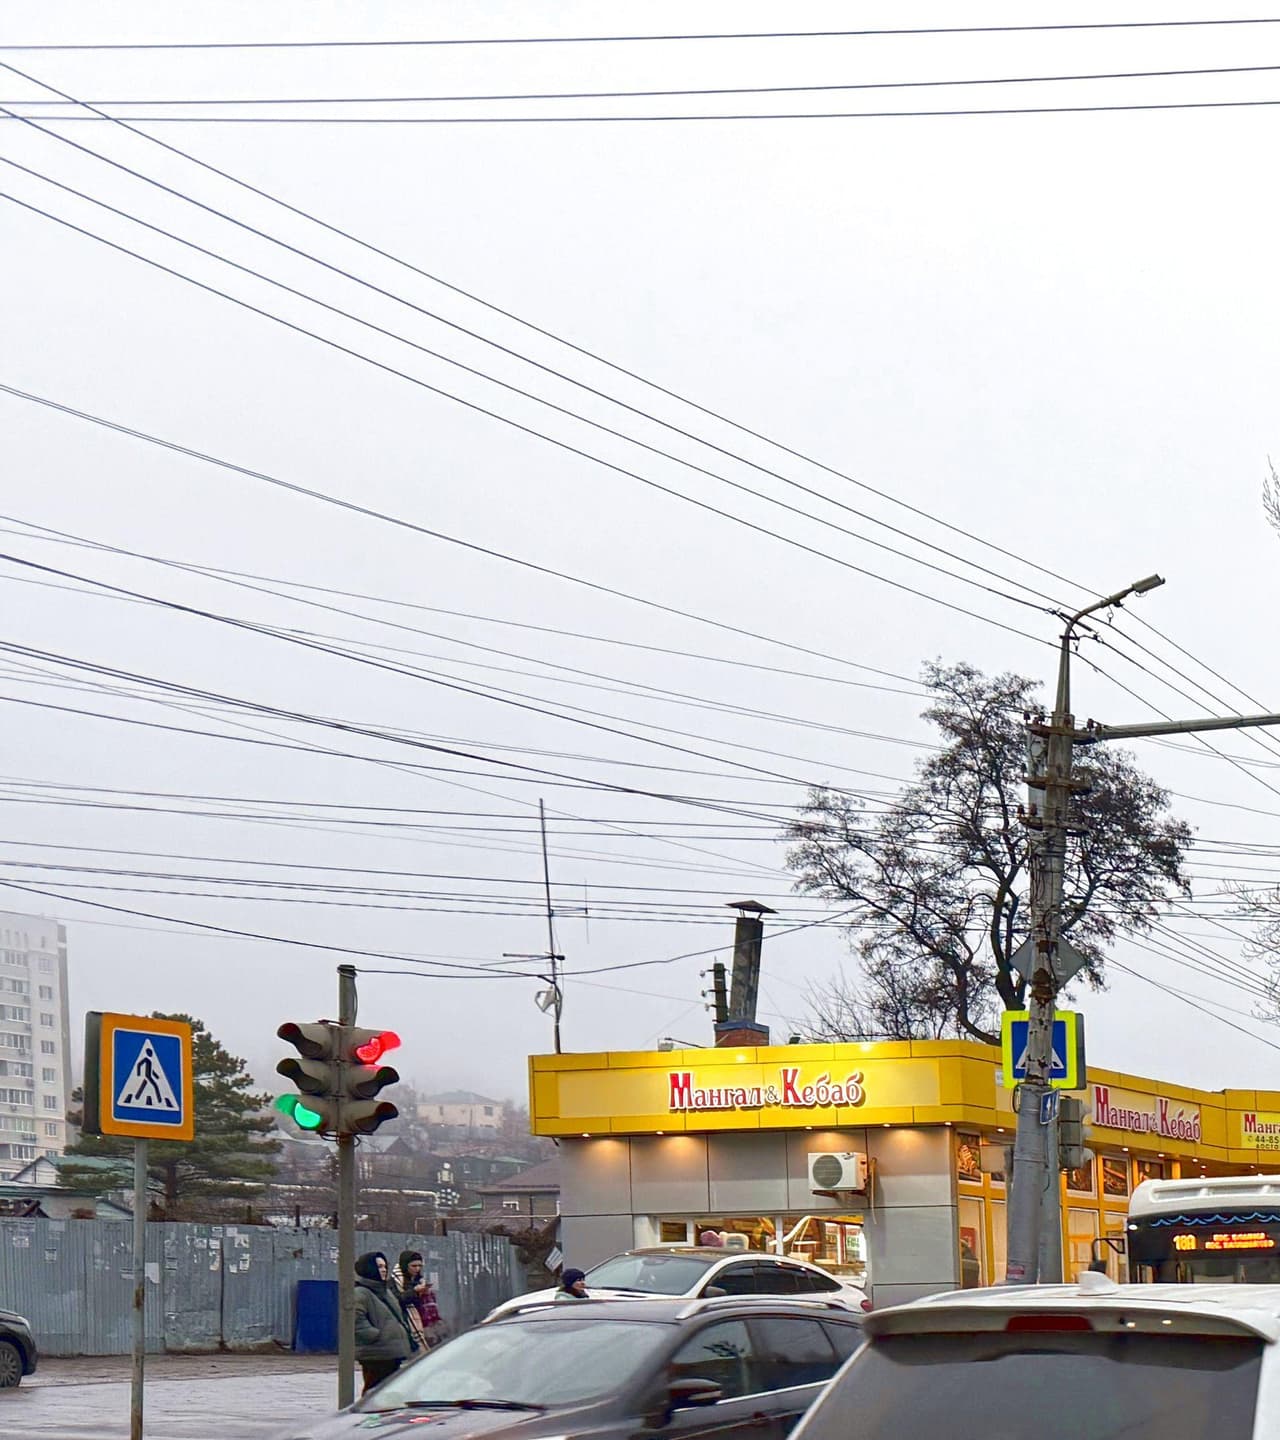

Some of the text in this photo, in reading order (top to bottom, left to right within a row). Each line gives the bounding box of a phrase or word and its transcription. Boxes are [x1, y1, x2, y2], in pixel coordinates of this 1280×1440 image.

[668, 1067, 866, 1109] Мангал & Кебаб
[1094, 1085, 1151, 1132] Мангал
[1158, 1097, 1201, 1140] Кебаб
